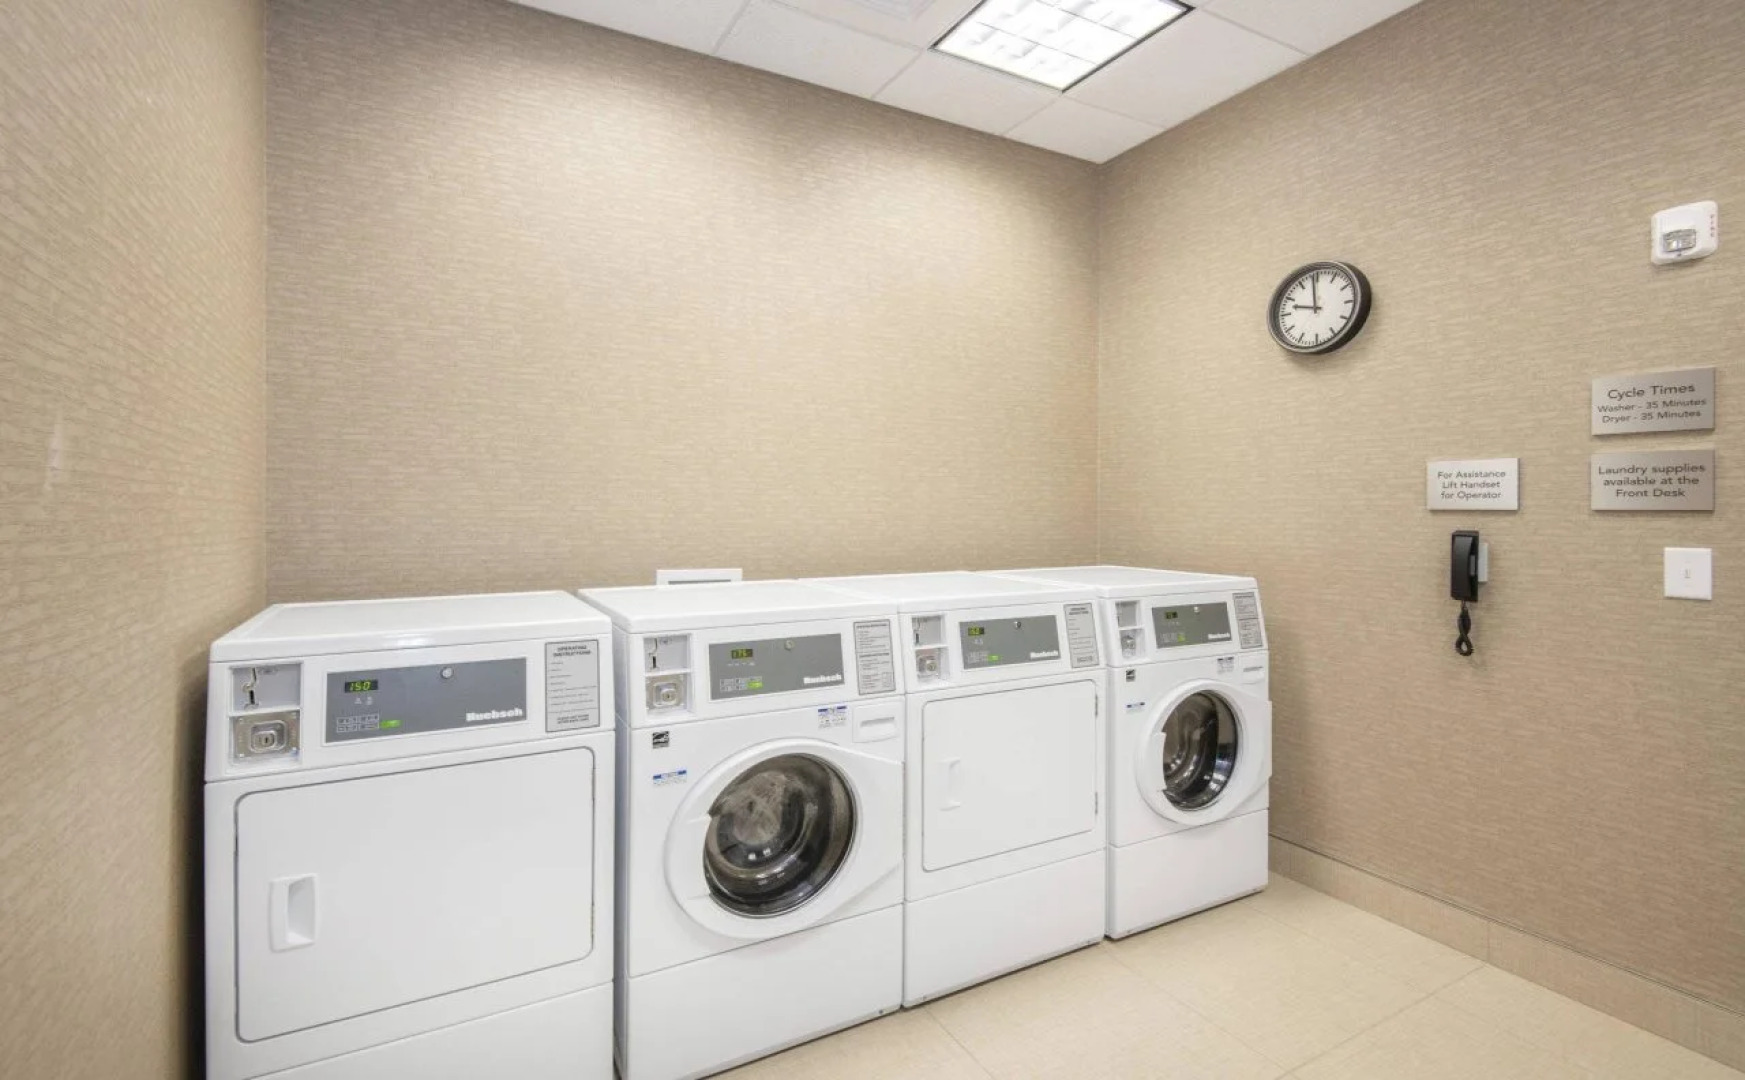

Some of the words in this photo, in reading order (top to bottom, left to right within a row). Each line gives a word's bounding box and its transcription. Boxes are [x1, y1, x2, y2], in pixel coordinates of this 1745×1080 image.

[1607, 387, 1645, 401] Cycle
[1651, 384, 1695, 395] Times
[1597, 404, 1635, 413] Washer
[1646, 401, 1659, 410] 35
[1662, 398, 1707, 408] Minutes
[1602, 414, 1632, 424] Dryer
[1640, 412, 1653, 421] 35
[1657, 410, 1702, 420] Minutes
[1437, 471, 1453, 479] For
[1455, 470, 1506, 478] Assistance
[1598, 465, 1648, 476] Laundry
[1652, 463, 1707, 475] supplies
[1442, 481, 1457, 489] Lift
[1461, 480, 1501, 489] Handset
[1603, 476, 1656, 486] available
[1660, 477, 1673, 485] at
[1677, 475, 1700, 485] the
[1440, 491, 1454, 499] for
[1457, 490, 1502, 501] Operator
[1616, 488, 1649, 498] Front
[1653, 488, 1686, 497] Desk
